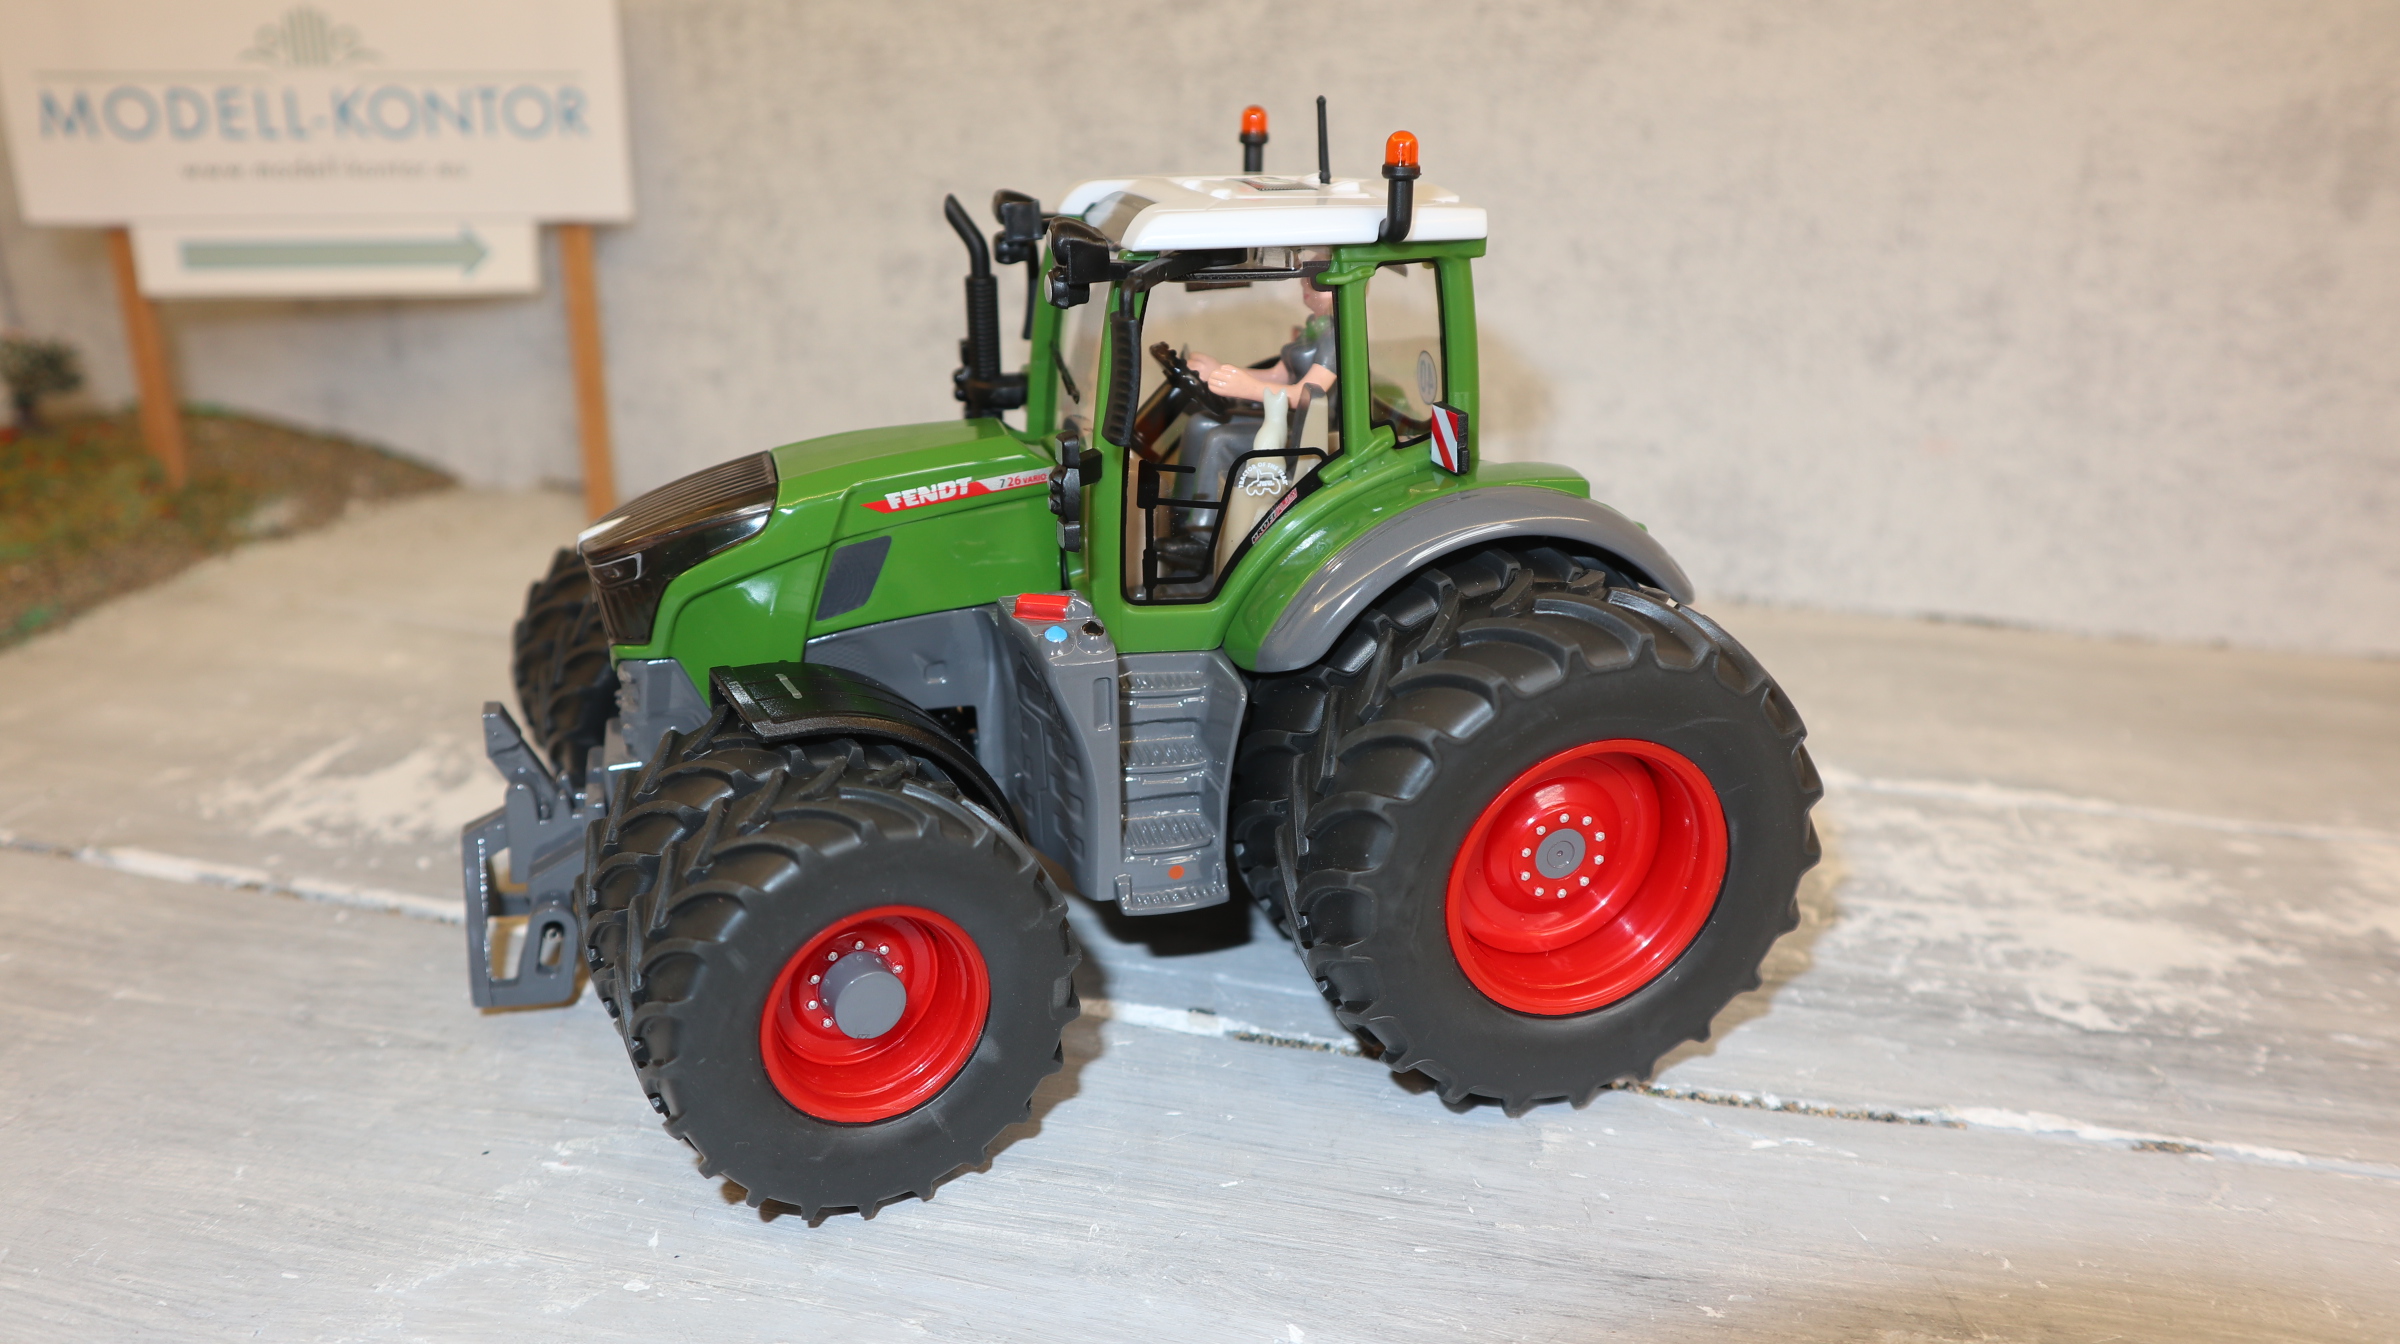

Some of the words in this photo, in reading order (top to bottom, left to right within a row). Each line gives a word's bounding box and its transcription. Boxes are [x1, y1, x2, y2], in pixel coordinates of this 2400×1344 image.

[38, 86, 590, 140] MODELL-KONTOR
[884, 476, 972, 510] FENDT
[1022, 473, 1048, 484] VARIO
[1238, 464, 1257, 489] TRACTOR
[1267, 462, 1279, 472] THE
[1277, 468, 1289, 486] YEAR
